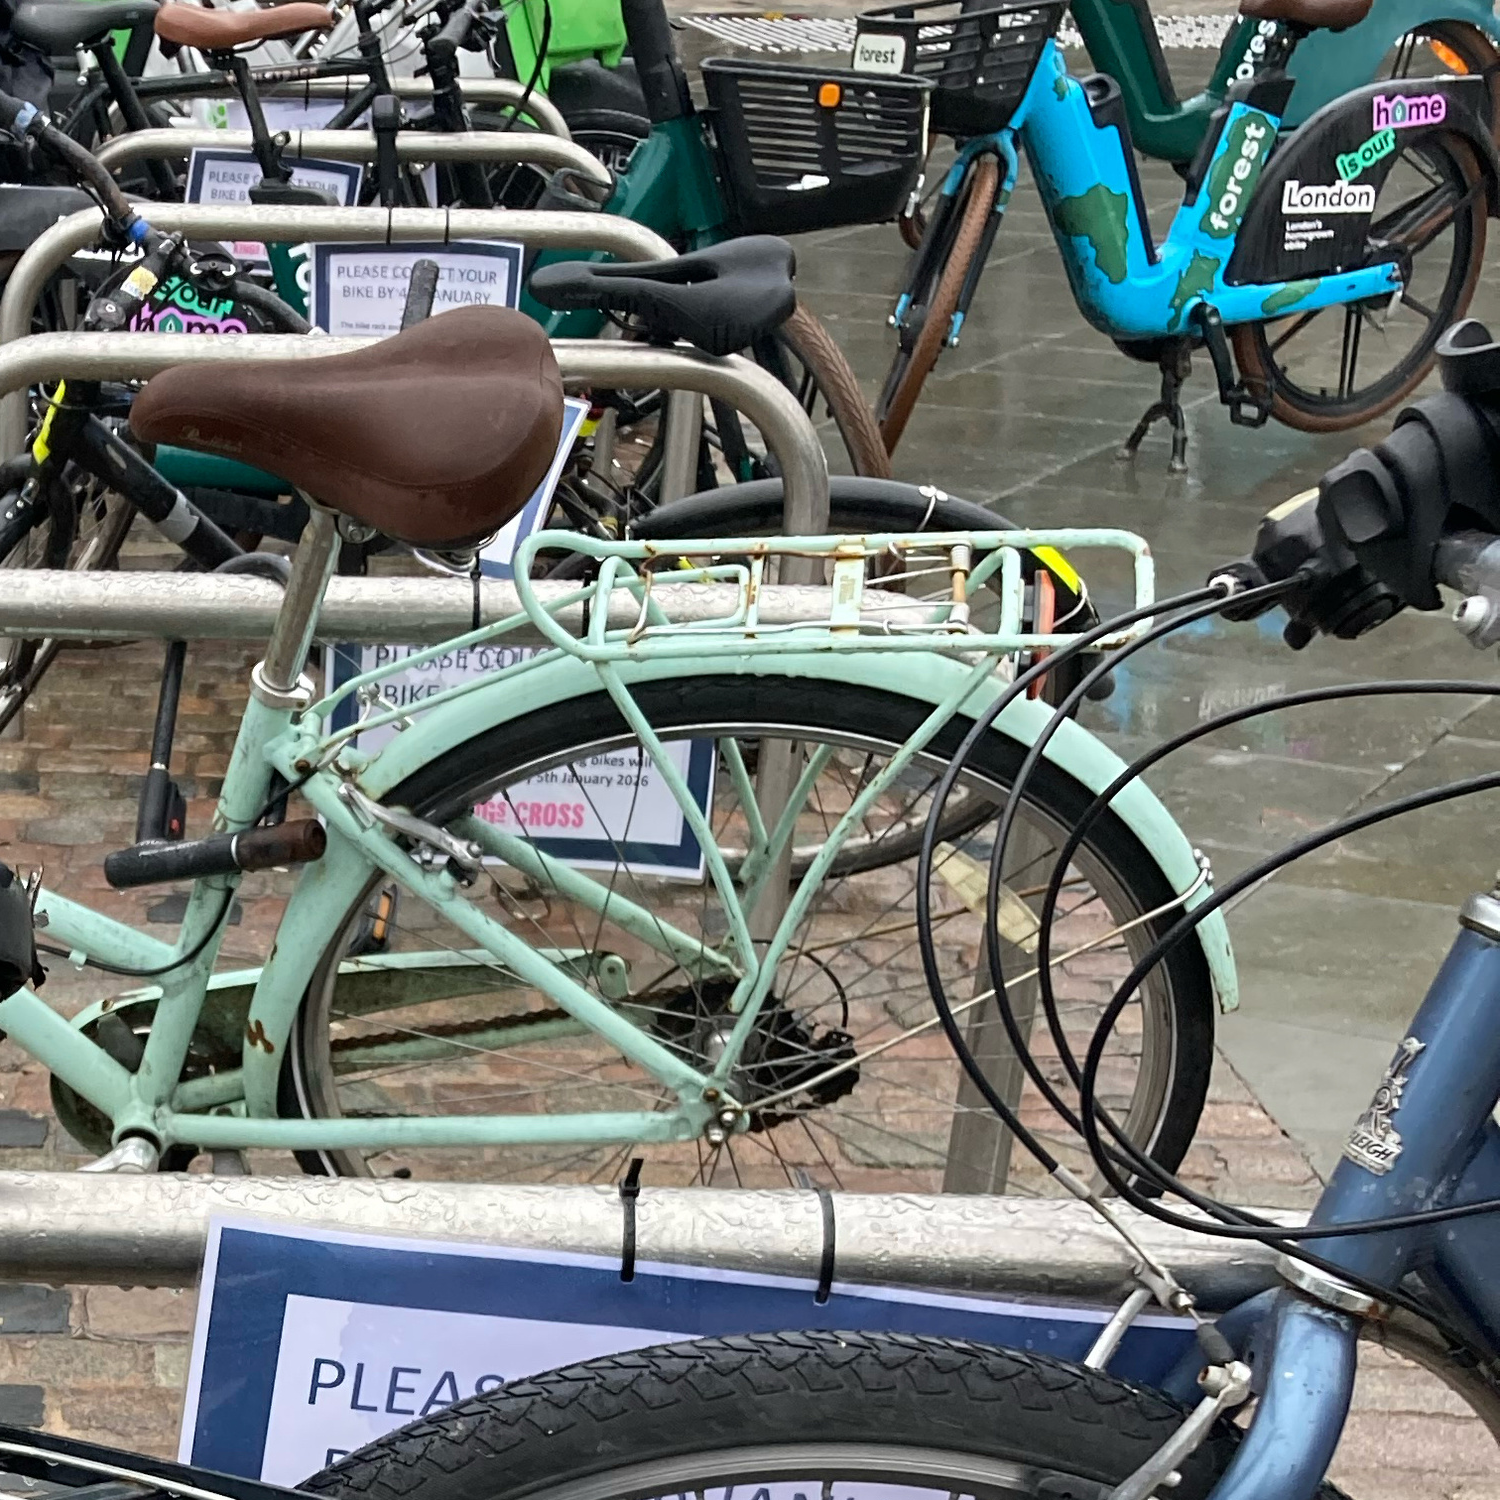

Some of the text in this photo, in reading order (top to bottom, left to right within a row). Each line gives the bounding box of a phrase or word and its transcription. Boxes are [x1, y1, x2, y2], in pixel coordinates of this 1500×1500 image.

[1376, 98, 1443, 127] home
[1342, 131, 1391, 178] is our
[209, 170, 250, 185] PLEASE
[1210, 123, 1266, 230] forest
[210, 188, 237, 201] BIKE
[1287, 186, 1370, 208] London
[337, 265, 388, 279] PLEASE
[459, 268, 498, 285] YOUR
[342, 285, 373, 299] BIKE
[378, 286, 394, 299] BY
[434, 289, 492, 306] ANUARY
[537, 772, 558, 784] 5th
[562, 772, 614, 788] January
[616, 773, 649, 787] 2026
[516, 801, 585, 829] CROSS
[307, 1356, 505, 1417] PLEA
